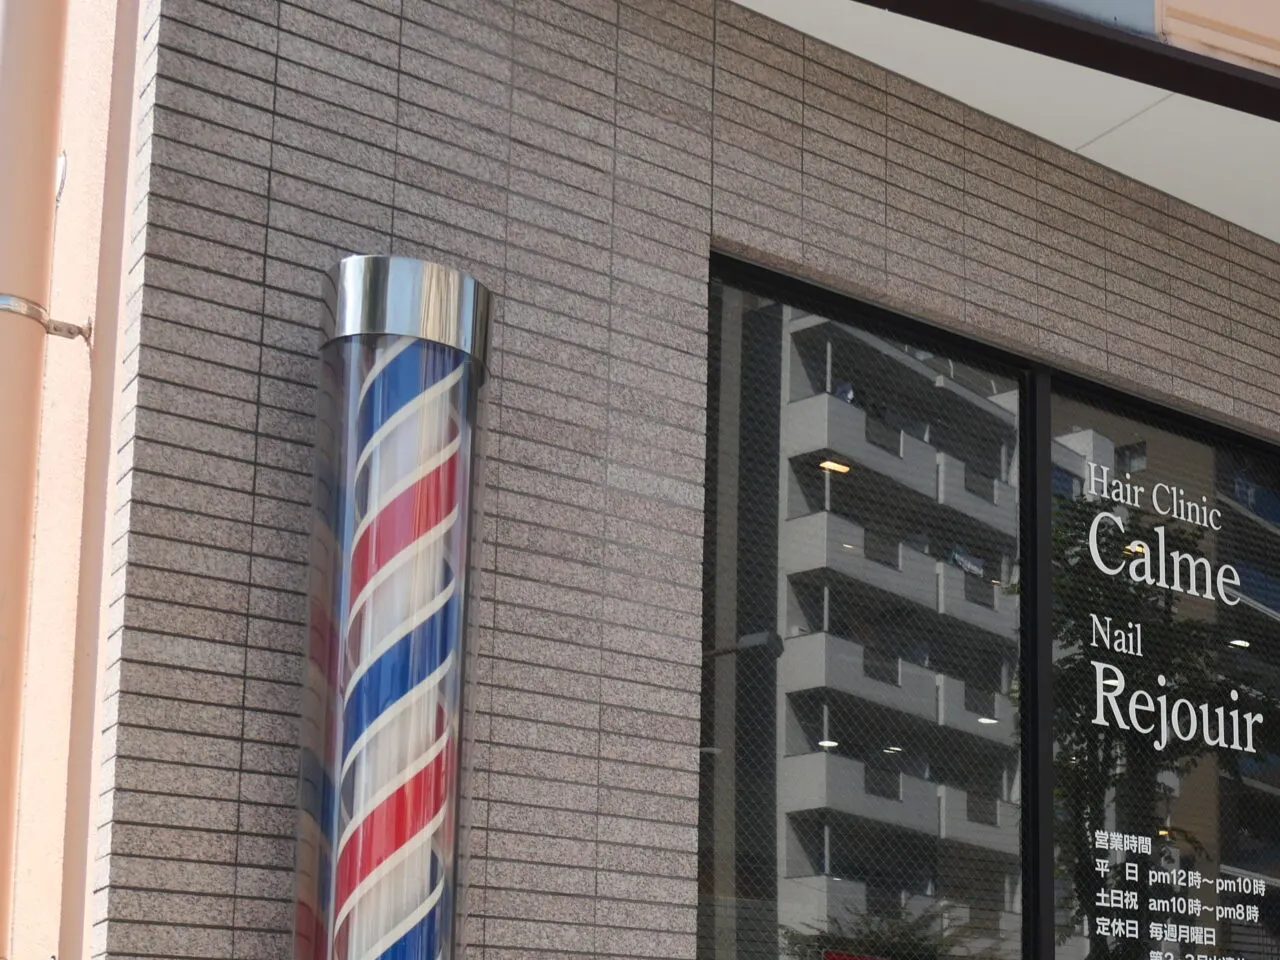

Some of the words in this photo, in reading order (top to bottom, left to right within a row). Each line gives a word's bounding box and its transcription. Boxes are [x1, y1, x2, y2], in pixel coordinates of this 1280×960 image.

[1088, 462, 1144, 508] Hair
[1152, 483, 1222, 530] Clinic
[1088, 511, 1241, 606] Calme
[1090, 613, 1143, 657] Nail
[1090, 660, 1263, 753] Rejouir
[1094, 830, 1152, 855] 営業時間
[1095, 889, 1138, 911] 土日祝
[1096, 917, 1139, 939] 定休日
[1149, 922, 1216, 946] 毎週月曜日
